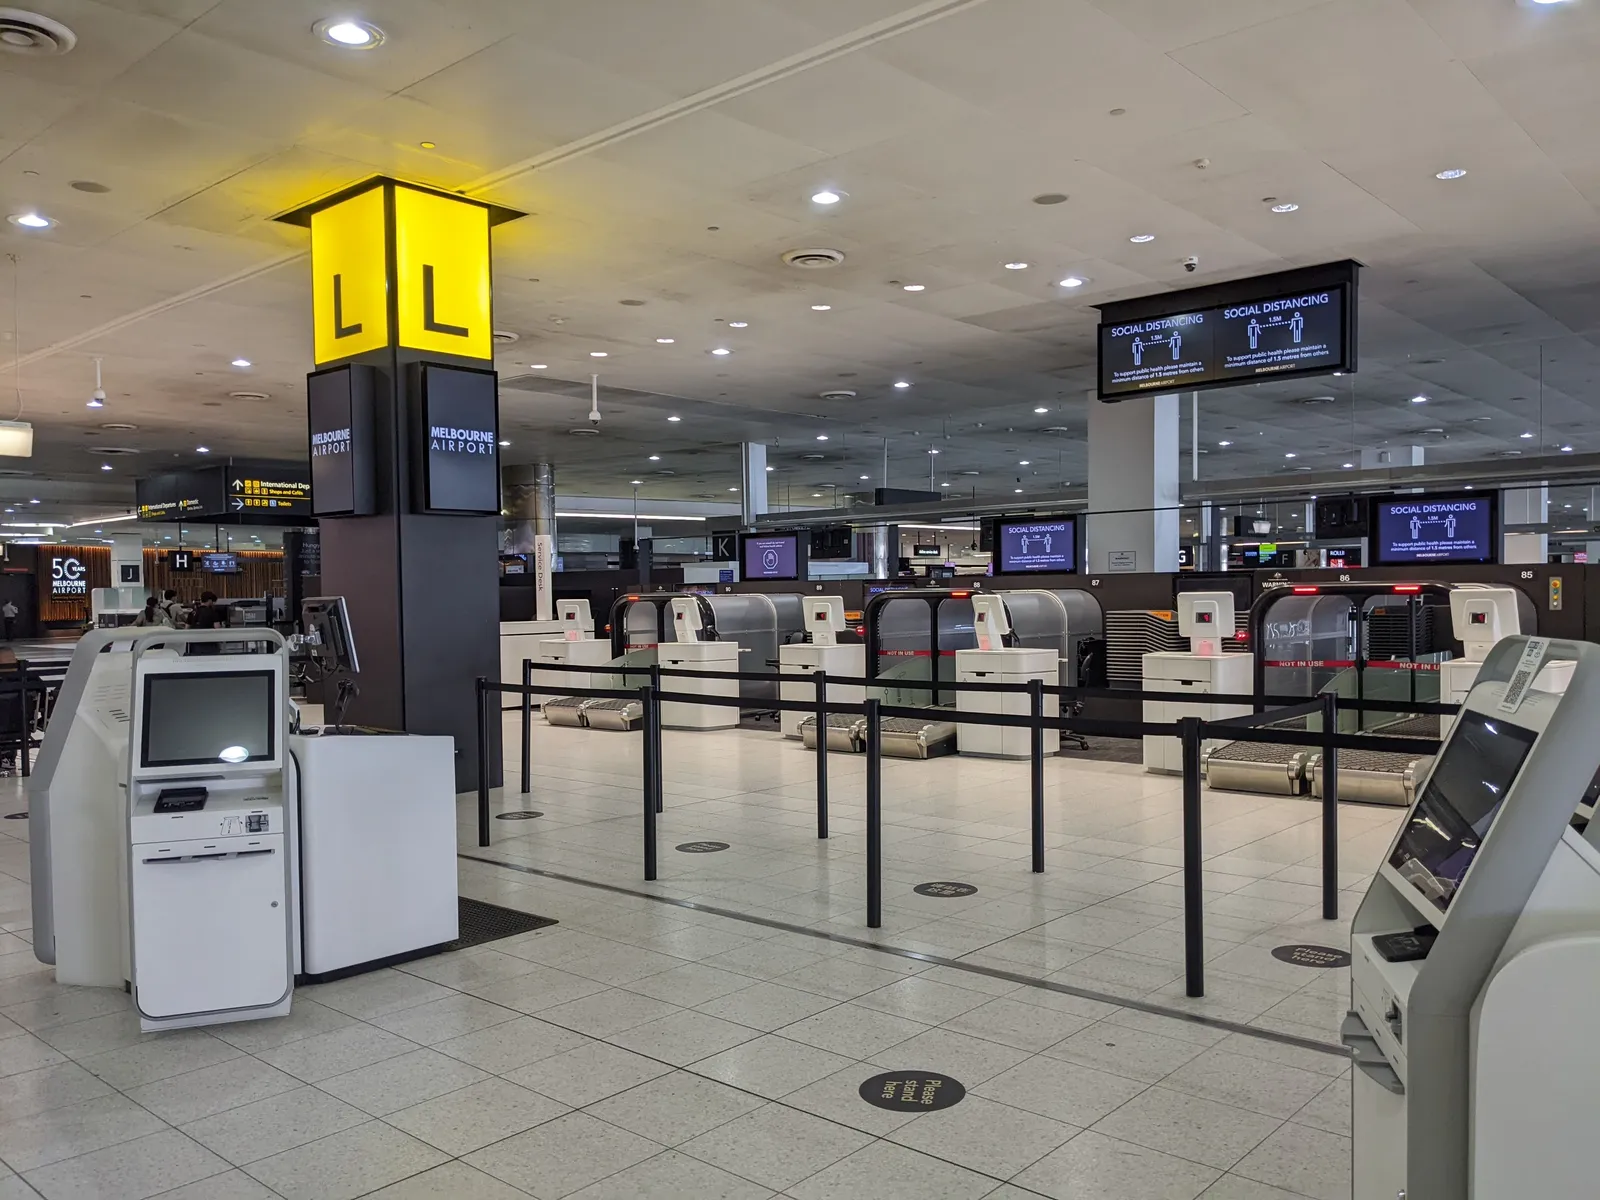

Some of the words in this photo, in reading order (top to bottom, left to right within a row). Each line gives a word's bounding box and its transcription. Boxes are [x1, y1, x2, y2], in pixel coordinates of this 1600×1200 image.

[333, 274, 363, 339] L
[423, 264, 469, 337] L
[1224, 305, 1261, 319] SOCIAL
[1263, 293, 1329, 313] DISTANCING
[1111, 324, 1144, 337] SOCIAL
[1146, 314, 1203, 332] DISTANCING
[1252, 351, 1267, 359] public
[1283, 347, 1300, 355] please
[1120, 369, 1136, 377] support
[1136, 367, 1150, 375] public
[1164, 363, 1178, 371] please
[312, 428, 350, 445] MELBOURNE
[431, 426, 494, 443] MELBOURNE
[312, 440, 350, 457] AIRPORT
[431, 440, 494, 455] AIRPORT
[261, 481, 297, 489] International
[1390, 506, 1421, 515] SOCIAL
[1423, 503, 1476, 513] DISTANCING
[1029, 525, 1065, 533] DISTANCING
[718, 538, 730, 557] K
[176, 554, 188, 568] H
[1178, 550, 1187, 563] G
[1282, 554, 1288, 565] F
[127, 568, 133, 580] J
[1521, 571, 1533, 579] 85
[1400, 662, 1419, 670] NOT
[881, 1080, 903, 1099] here
[901, 1079, 920, 1102] stand
[921, 1079, 942, 1105] Please
